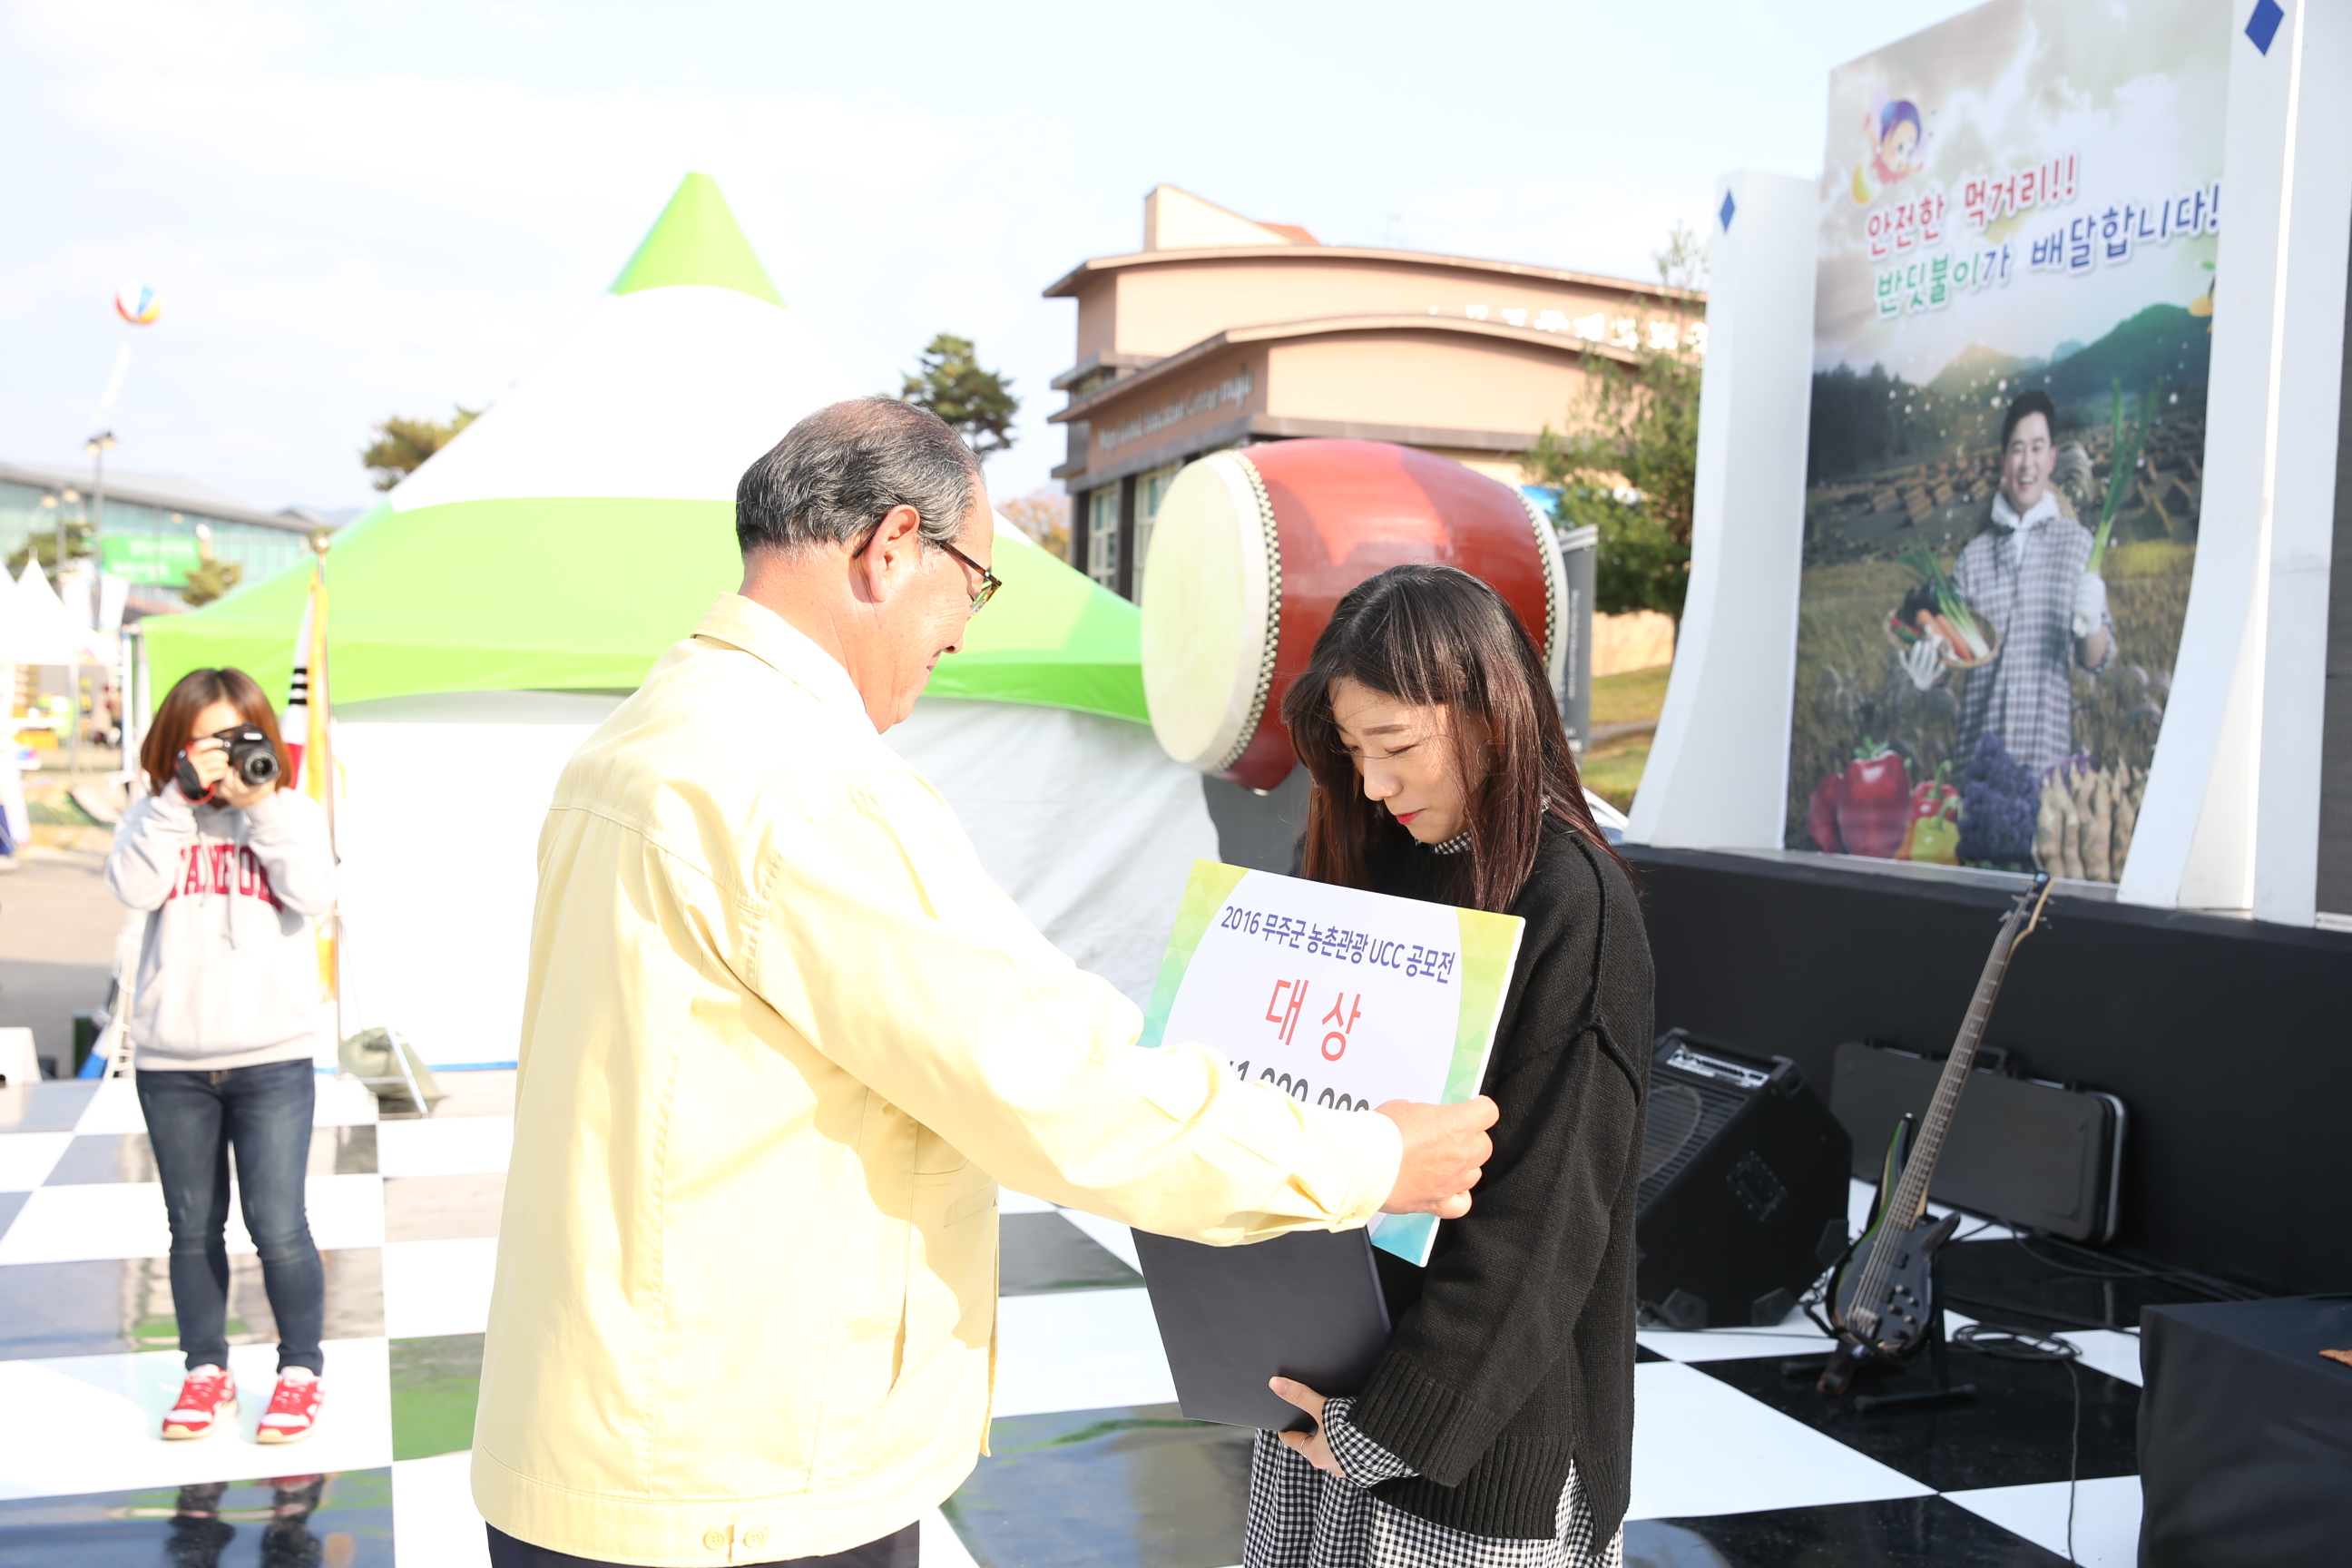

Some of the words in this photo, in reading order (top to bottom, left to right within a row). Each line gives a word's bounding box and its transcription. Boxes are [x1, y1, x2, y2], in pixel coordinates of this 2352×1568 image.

[1868, 193, 1945, 256] 안전한
[1965, 155, 2074, 227] 먹거리!!
[1877, 243, 2010, 314] 반딧불이가
[2032, 184, 2220, 269] 배달합니다!
[1221, 906, 1262, 935] 2016
[1262, 913, 1307, 949] 무주군
[1308, 923, 1368, 965] 농촌관광
[1369, 938, 1406, 969] UCC
[1406, 945, 1455, 985] 공모전
